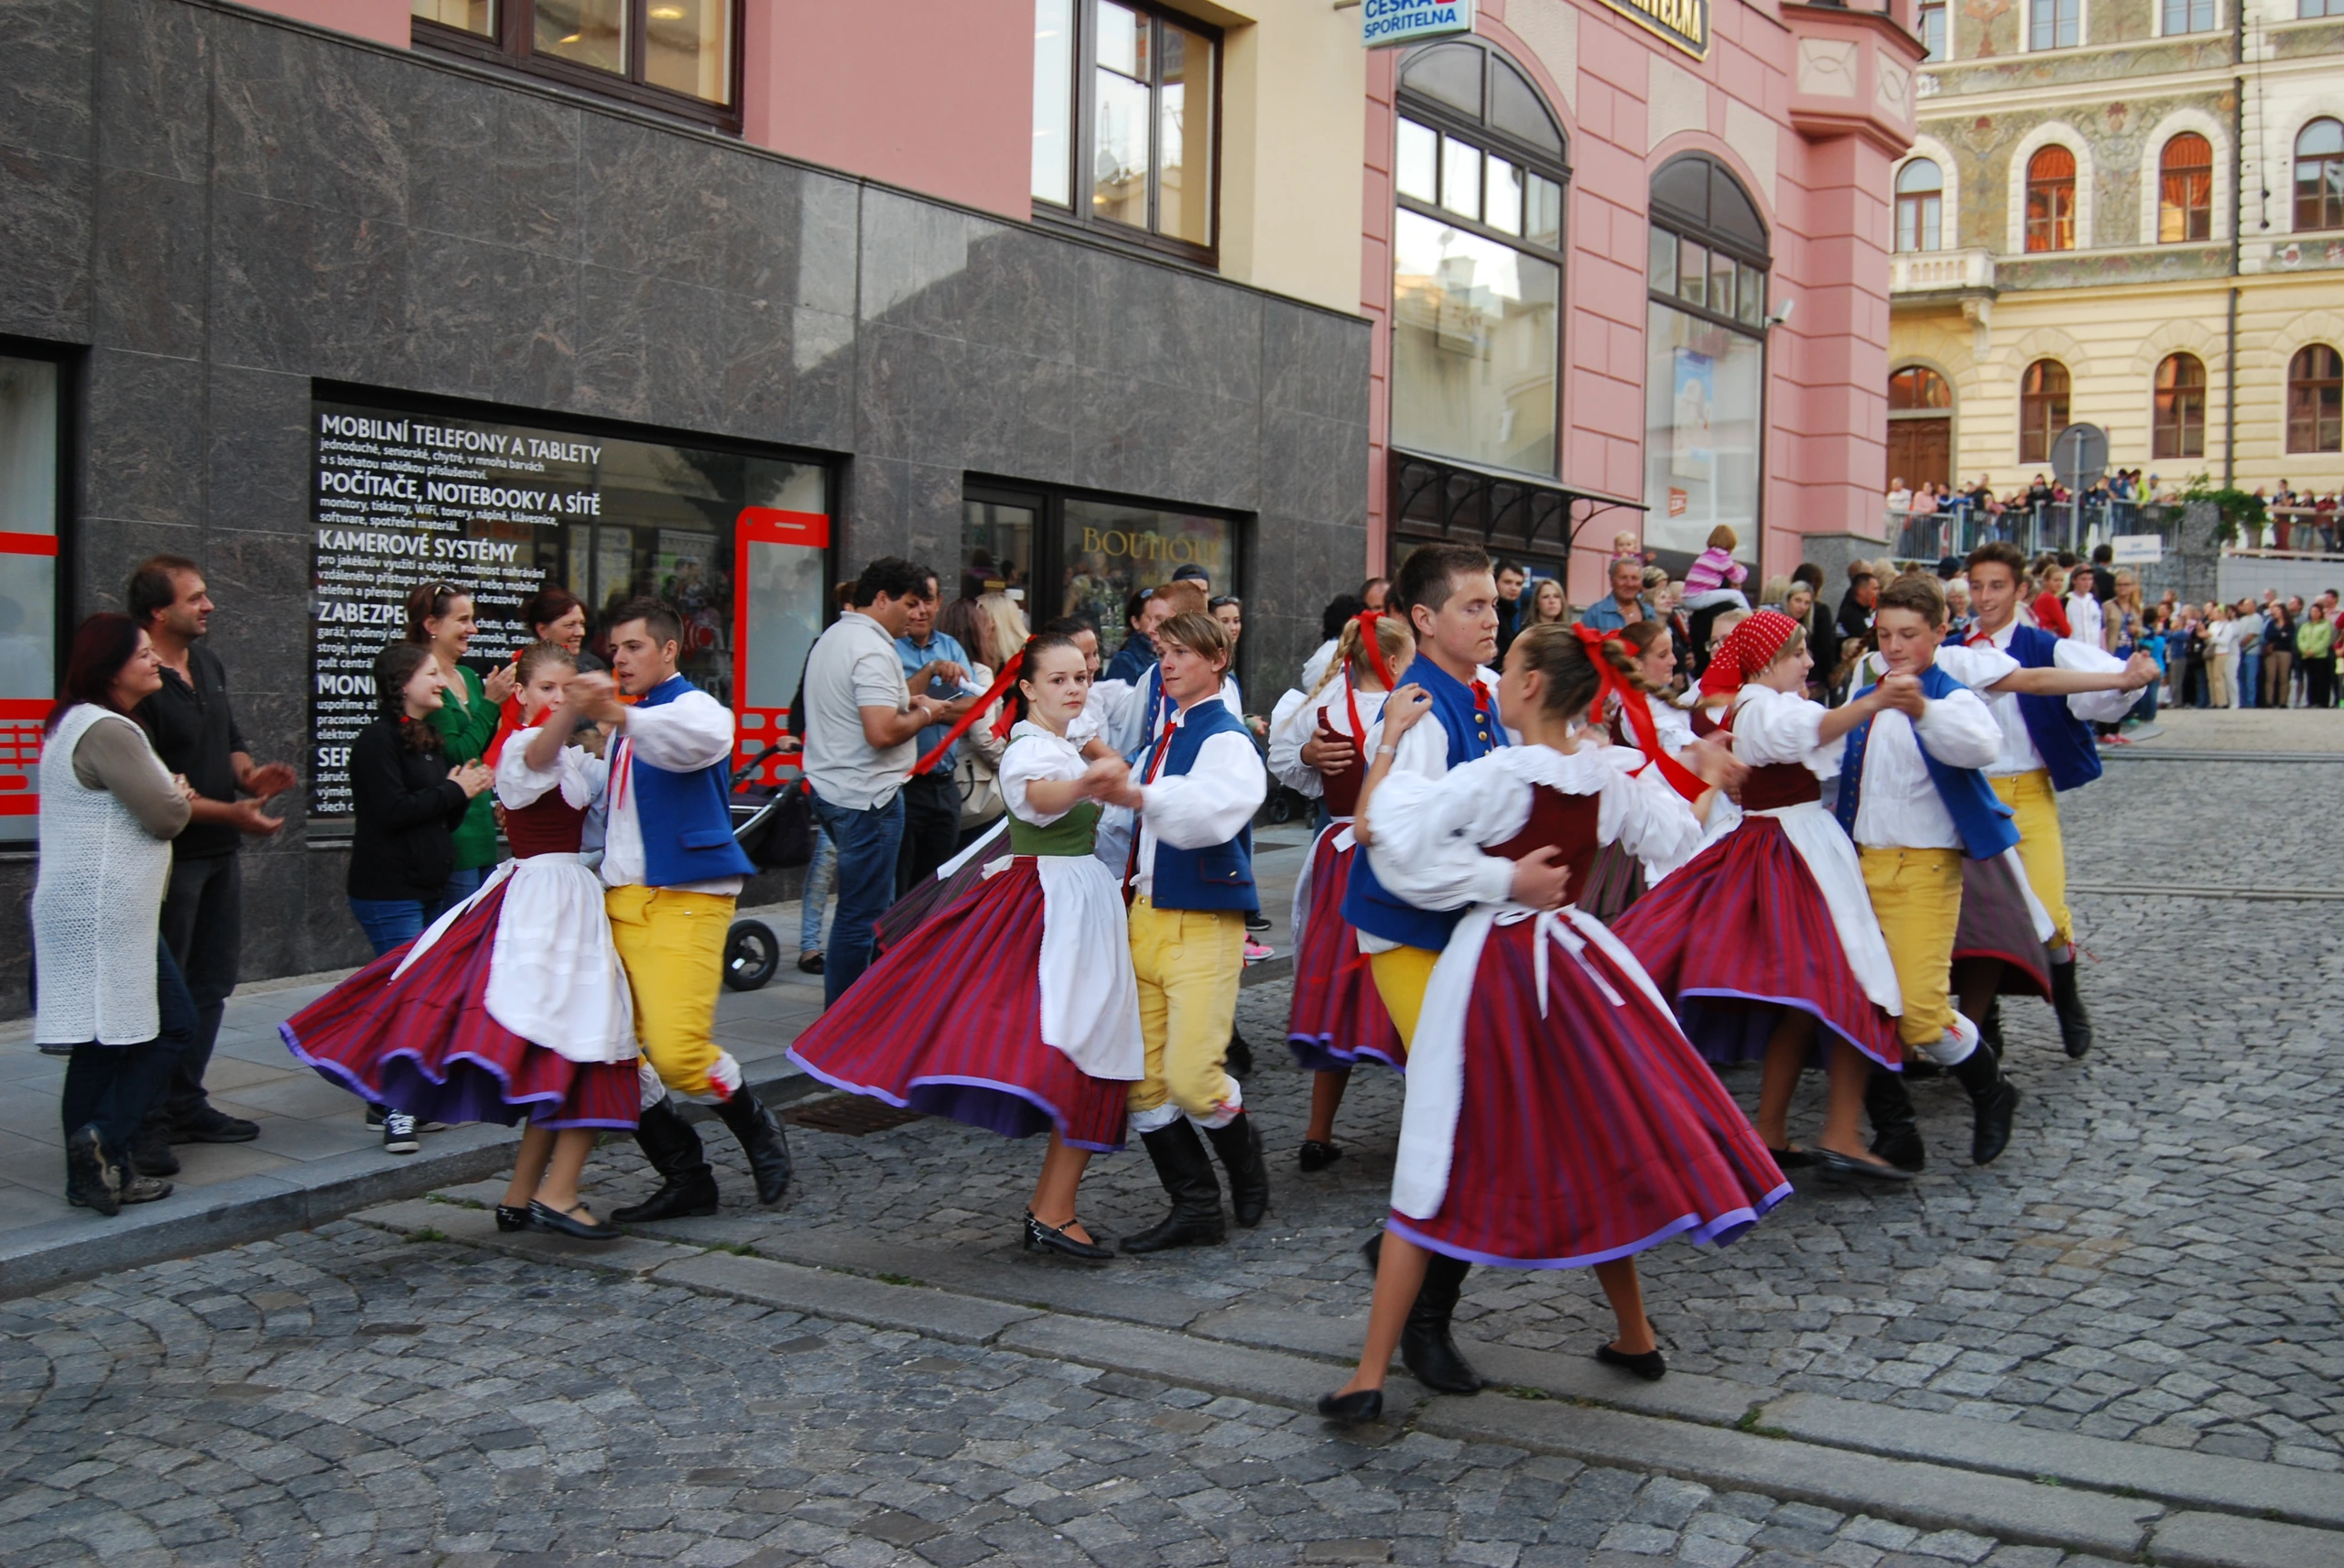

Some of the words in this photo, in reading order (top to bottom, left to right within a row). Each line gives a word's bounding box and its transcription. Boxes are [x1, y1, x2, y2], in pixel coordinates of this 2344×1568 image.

[1364, 8, 1457, 38] SPOŘITELNA
[321, 414, 409, 442] MOBILNÍ
[413, 424, 508, 453] TELEFONY
[511, 437, 525, 456] A
[527, 438, 602, 464] TABLETY
[320, 438, 381, 456] jednoduché,
[383, 446, 431, 460] seniorské,
[432, 449, 465, 464] chytré,
[467, 456, 474, 464] v
[475, 457, 507, 469] mnoha
[508, 459, 545, 472] barvách
[320, 455, 327, 464] a
[329, 456, 335, 464] s
[337, 454, 379, 469] bohatou
[381, 460, 426, 474] nabídkou
[427, 465, 488, 480] příslušenství.
[320, 470, 423, 503] POČÍTAČE,
[428, 481, 547, 510] NOTEBOOKY
[548, 493, 562, 512] A
[566, 491, 601, 515] SÍTĚ
[320, 497, 369, 513] monitory,
[371, 500, 413, 515] tiskárny,
[440, 506, 474, 521] tonery,
[475, 508, 510, 523] náplně,
[511, 510, 559, 526] klávesnice,
[320, 512, 368, 526] software,
[369, 515, 417, 529] spotřební
[418, 519, 460, 531] materiál.
[319, 529, 429, 557] KAMEROVÉ
[434, 537, 518, 563] SYSTÉMY
[318, 555, 335, 567] pro
[336, 554, 381, 568] jakékoliv
[383, 557, 416, 571] využití
[418, 561, 424, 570] a
[426, 560, 459, 574] objekt,
[461, 563, 500, 576] možnost
[502, 567, 546, 579] nahrávání
[317, 568, 374, 582] vzdáleného
[376, 571, 417, 587] přístupu
[480, 578, 504, 589] nebo
[505, 581, 539, 592] mobilní
[318, 583, 353, 596] telefon
[355, 588, 363, 596] a
[364, 586, 404, 600] přenosu
[476, 593, 524, 608] obrazovky
[318, 601, 408, 624] ZABEZPE
[317, 625, 348, 639] garáž,
[350, 627, 387, 642] rodinný
[317, 643, 349, 655] stroje,
[317, 656, 338, 670] pult
[318, 675, 376, 695] MONI
[317, 698, 364, 712] uspoříme
[365, 699, 378, 709] až
[317, 713, 372, 728] pracovních
[316, 785, 353, 800] výměn
[316, 800, 346, 812] všech
